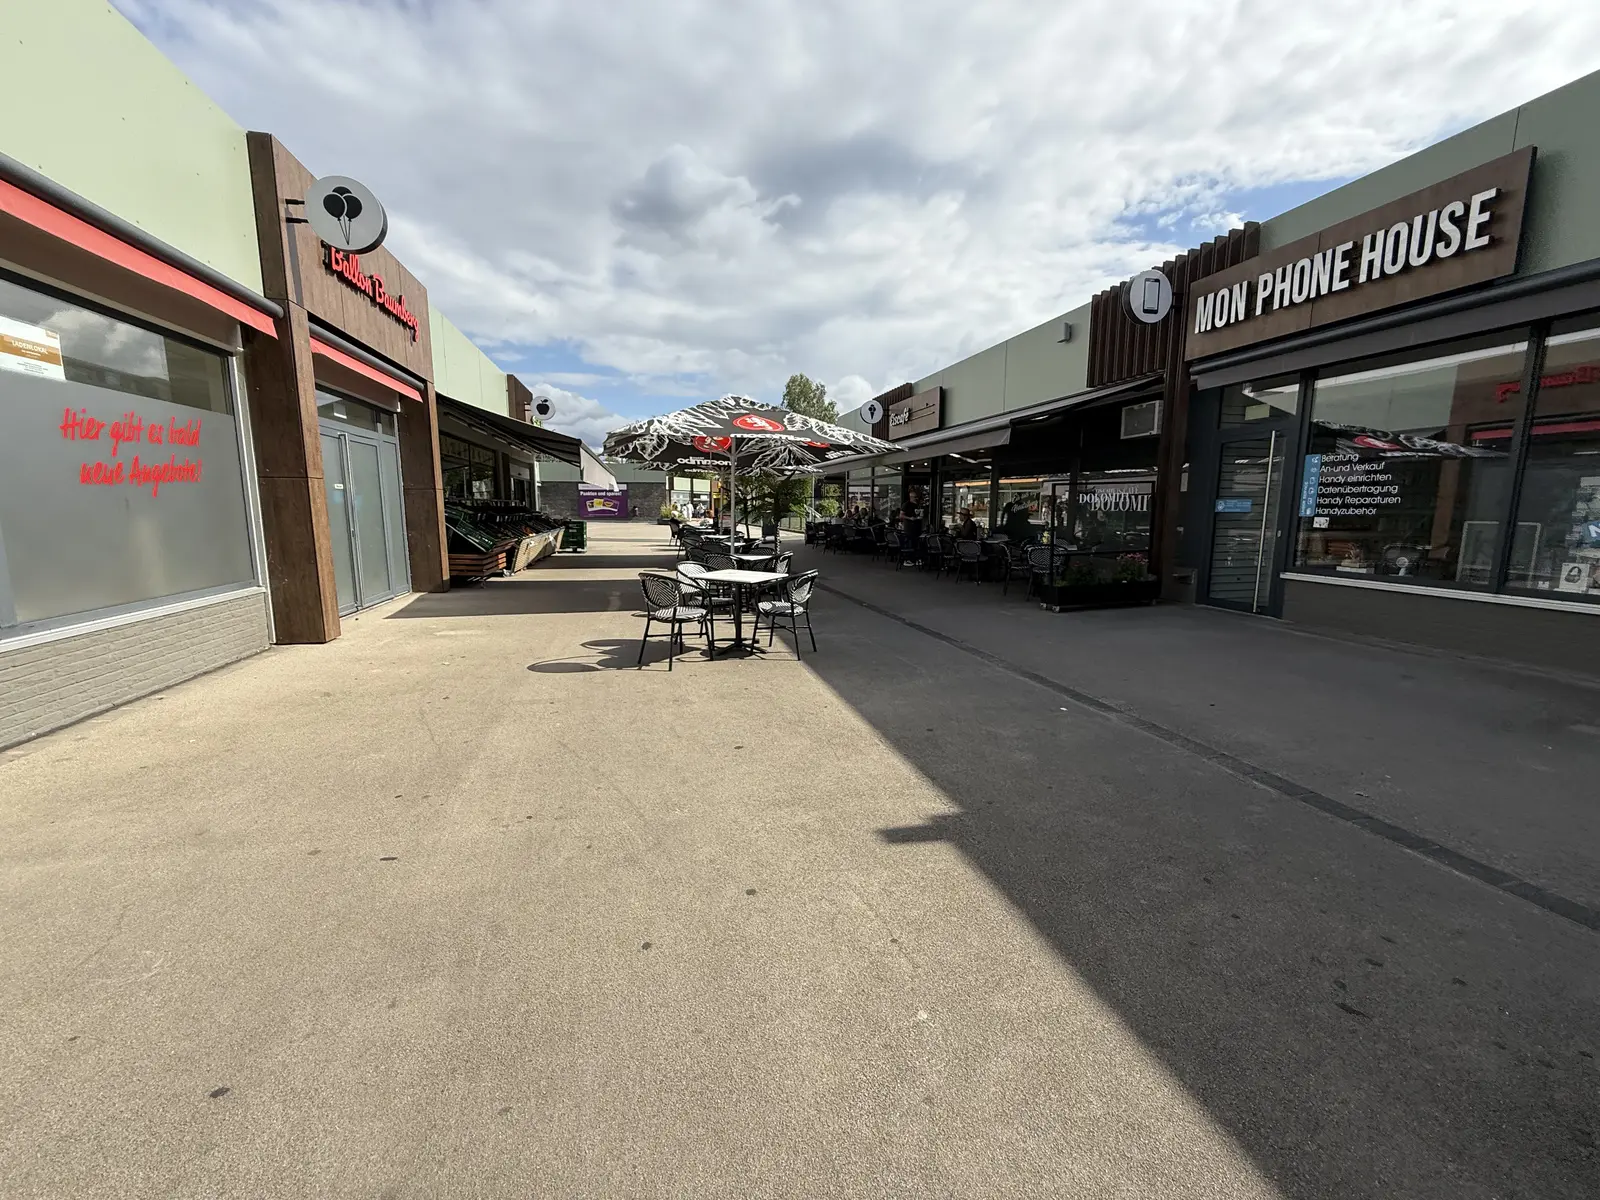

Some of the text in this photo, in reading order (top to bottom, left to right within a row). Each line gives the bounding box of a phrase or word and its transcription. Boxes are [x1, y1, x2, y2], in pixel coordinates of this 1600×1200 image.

[1194, 187, 1497, 334] MON PHONE HOUSE
[331, 246, 419, 342] Ballon Baumberg
[889, 407, 909, 427] Eiscafé
[59, 407, 202, 457] Hier gibt es bald
[1321, 453, 1359, 462] Beratung
[1319, 461, 1386, 473] An-und Verkauf
[80, 452, 202, 499] neue Angebote!
[1318, 473, 1392, 484] Handy einrichten
[1317, 485, 1399, 494] Datenübertragung
[1090, 494, 1152, 511] DOLOMI
[1316, 496, 1401, 506] Handy Reparaturen
[1315, 507, 1377, 515] Handyzubehör
